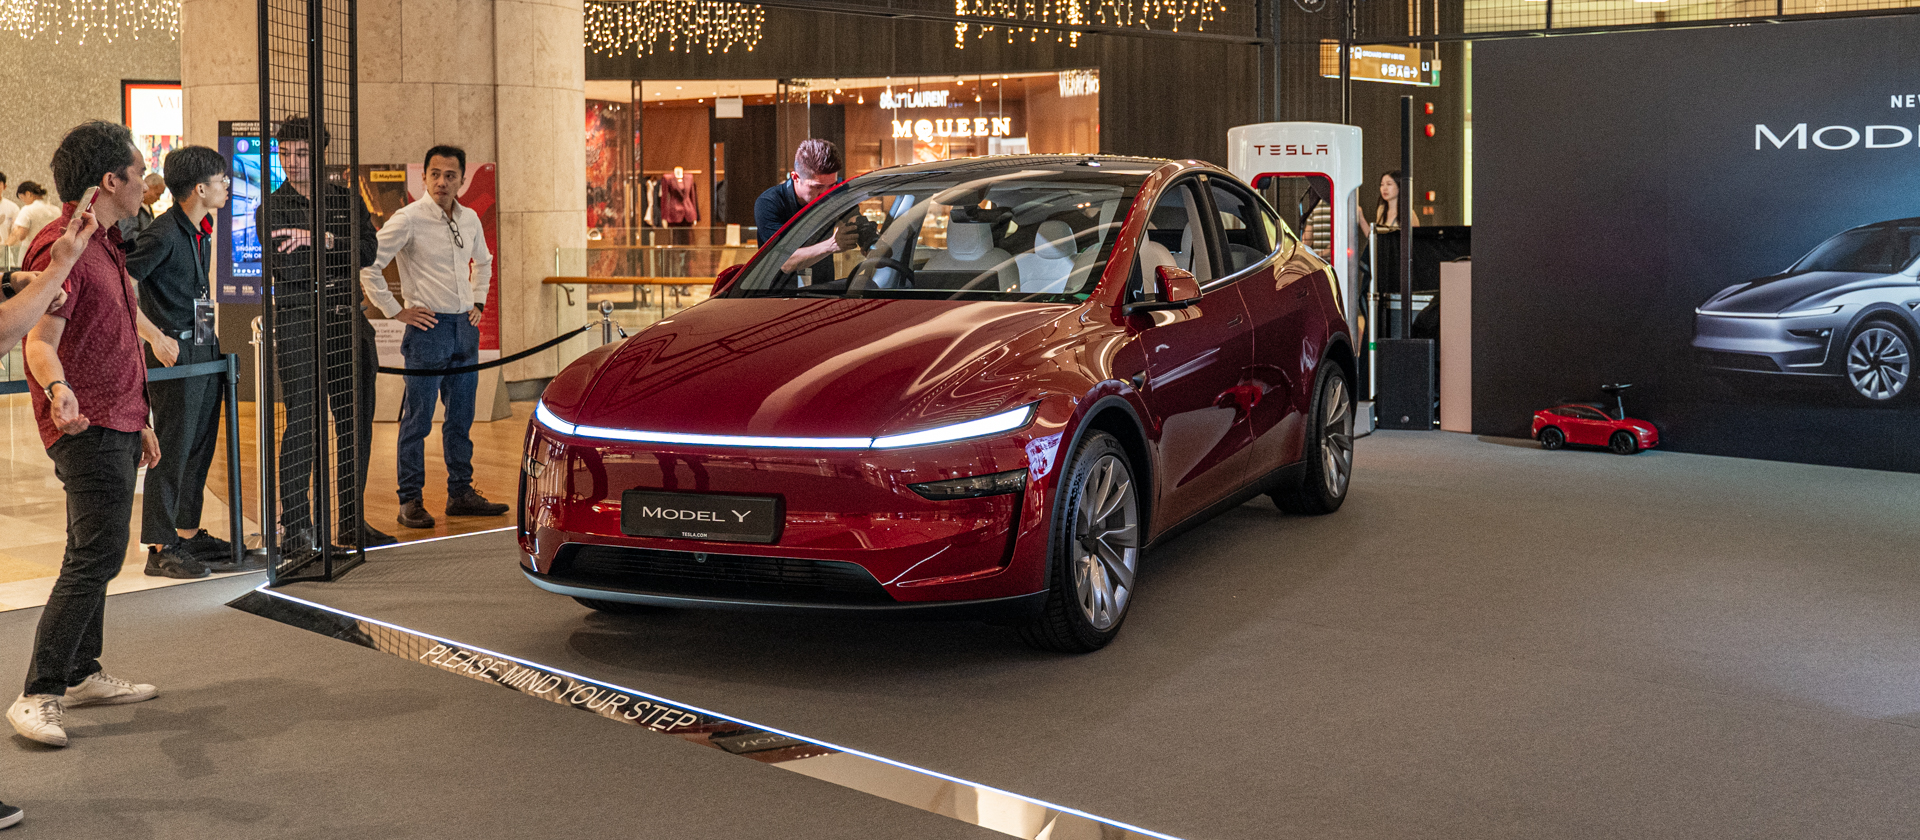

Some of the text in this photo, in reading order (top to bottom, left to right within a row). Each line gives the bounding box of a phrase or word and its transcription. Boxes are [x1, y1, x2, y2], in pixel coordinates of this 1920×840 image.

[1421, 61, 1430, 72] L1
[1755, 122, 1920, 151] MOD
[1253, 144, 1328, 156] TESLA
[642, 506, 751, 523] MODEL Y
[420, 644, 698, 731] PLEASE MIND YOUR STEP
